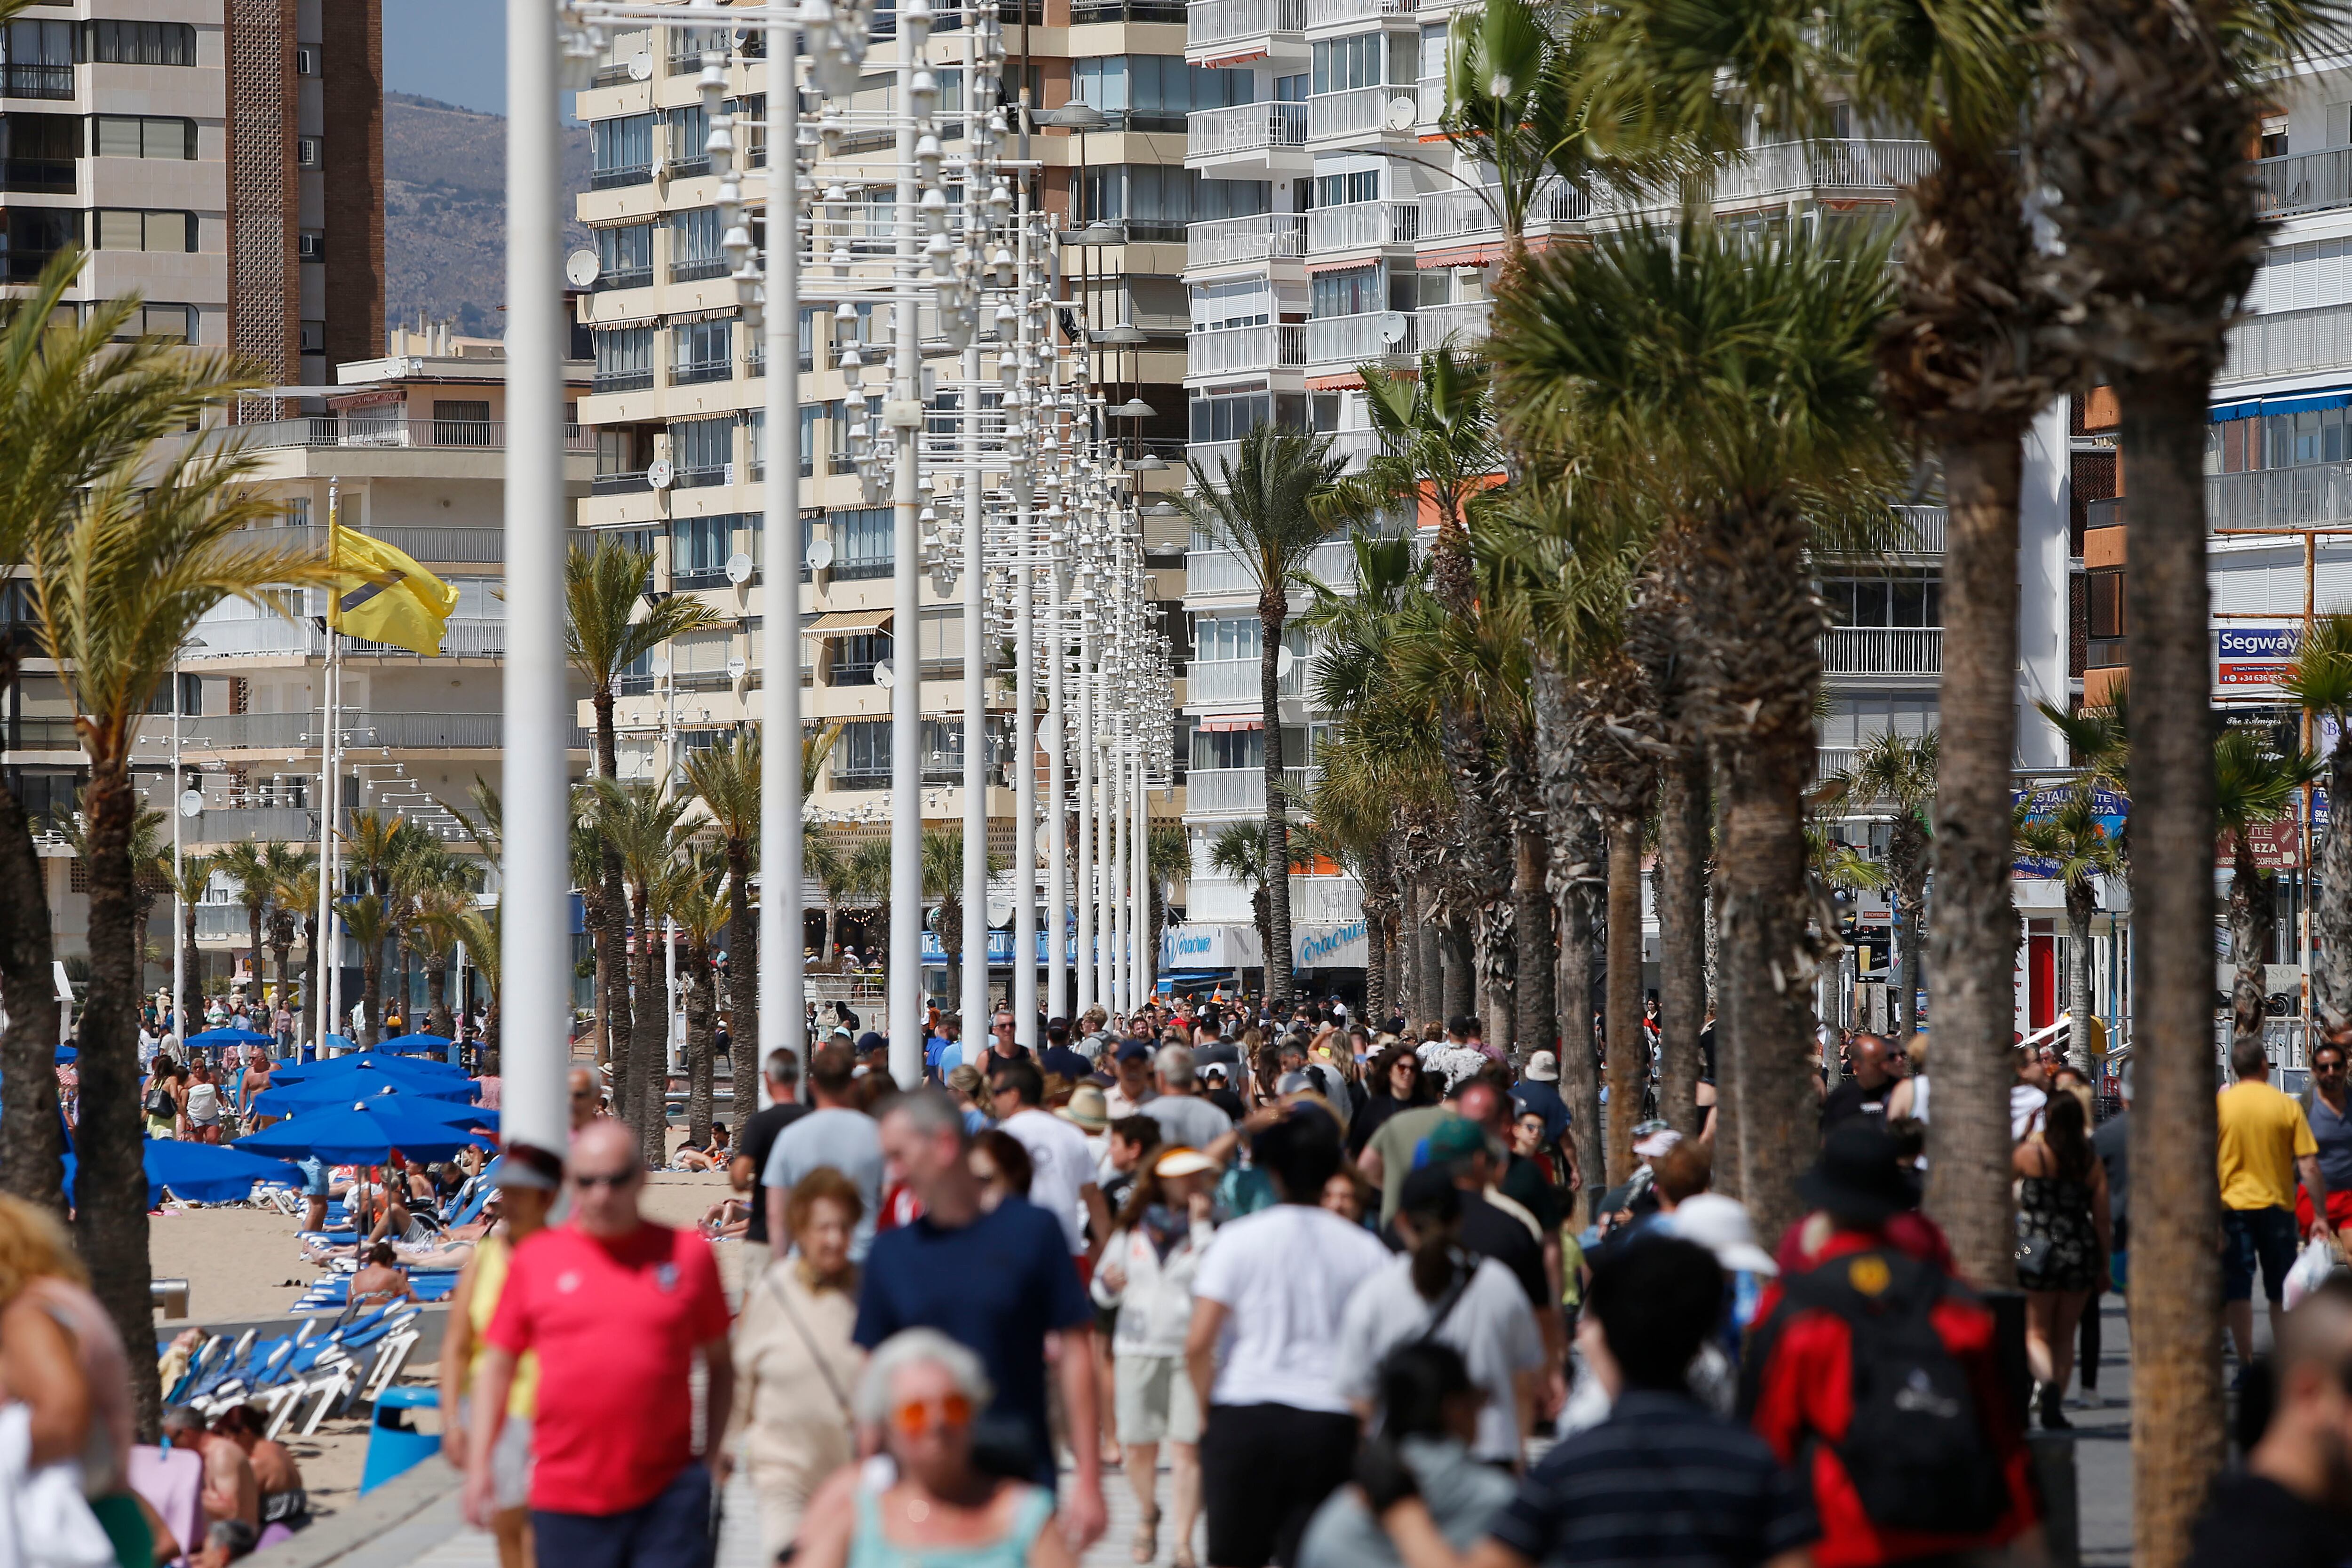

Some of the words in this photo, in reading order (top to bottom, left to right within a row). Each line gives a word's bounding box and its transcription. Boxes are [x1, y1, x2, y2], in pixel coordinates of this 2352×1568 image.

[2222, 633, 2298, 653] Segway
[2226, 716, 2241, 725] The
[2249, 716, 2281, 727] Amigos
[2314, 809, 2329, 818] SKA
[2230, 842, 2278, 853] BLEZA
[1165, 931, 1211, 963] Veracruz
